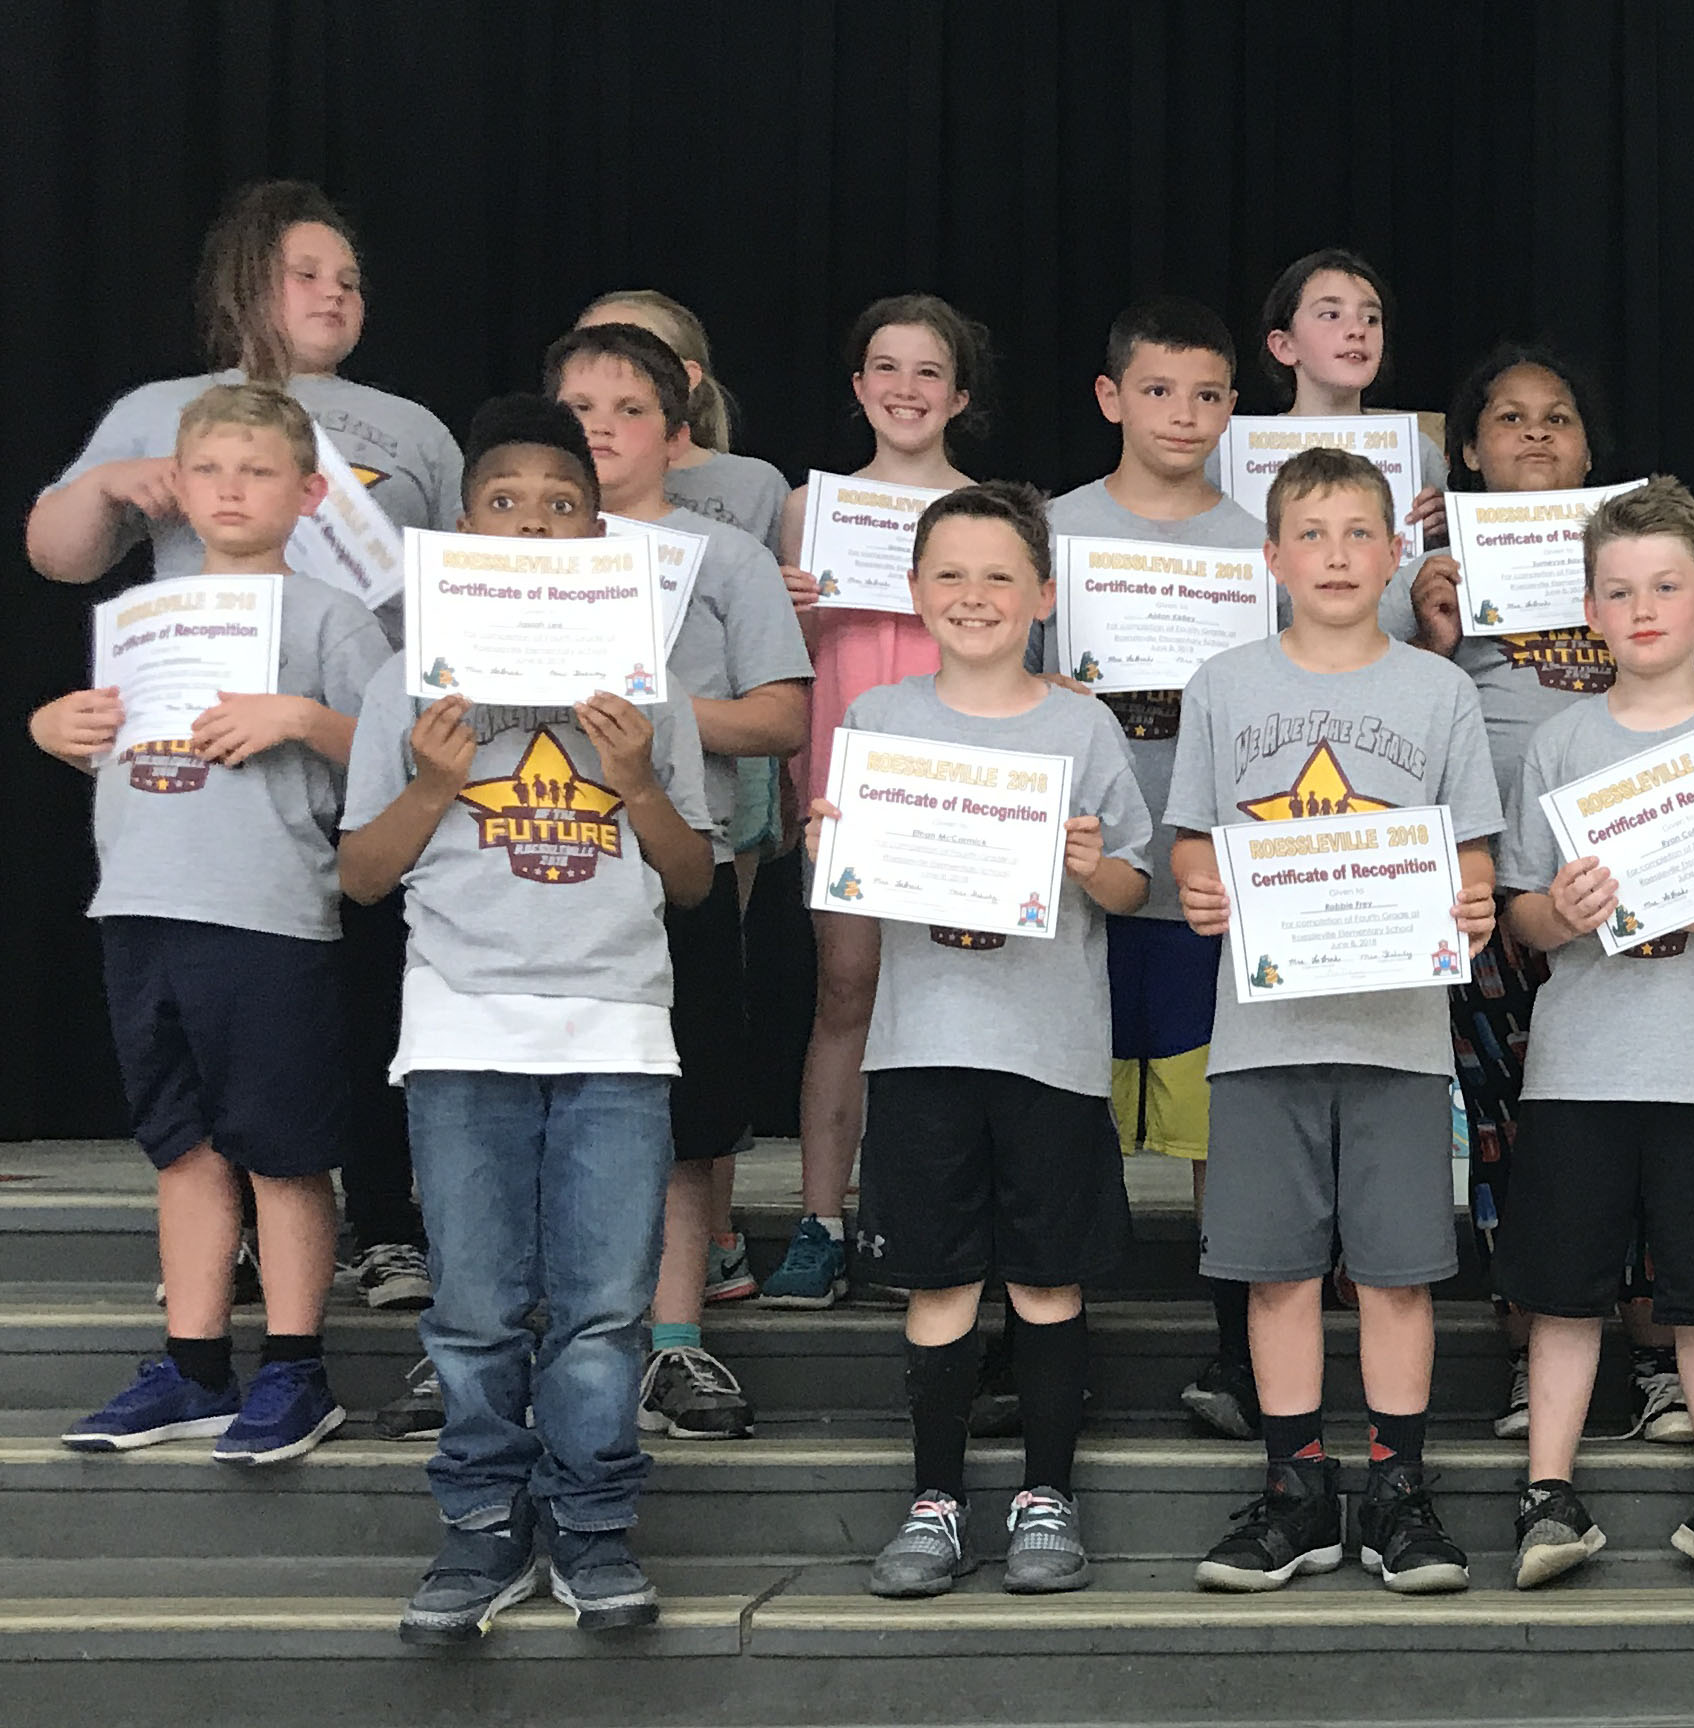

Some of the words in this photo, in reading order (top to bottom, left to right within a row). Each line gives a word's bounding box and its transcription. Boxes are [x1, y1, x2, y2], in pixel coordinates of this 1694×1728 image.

[832, 510, 900, 531] Certificate
[902, 522, 916, 533] of
[1476, 532, 1543, 547] Certificate
[1547, 530, 1558, 543] of
[1215, 562, 1254, 581] 2018
[438, 580, 522, 600] Certificate
[527, 586, 542, 600] of
[548, 584, 638, 604] Recognition
[1085, 579, 1157, 595] Certificate
[1161, 584, 1174, 597] of
[1178, 585, 1257, 604] Recognition
[1234, 725, 1261, 784] WE
[1262, 712, 1305, 758] ARE
[1307, 710, 1353, 747] THE
[1355, 715, 1427, 782] STARS
[867, 750, 998, 787] ROESSLEVILLE
[1007, 770, 1048, 793] 2018
[859, 784, 938, 810] Certificate
[942, 796, 957, 812] of
[962, 798, 1048, 823] Recognition
[485, 817, 618, 852] FUTURE
[1588, 808, 1658, 845] Certificate
[1660, 797, 1675, 815] of
[1249, 828, 1379, 860] ROESSLEVILLE
[1386, 824, 1429, 847] 2018
[1251, 869, 1328, 887] Certificate
[1332, 865, 1347, 881] of
[1351, 858, 1437, 880] Recognition
